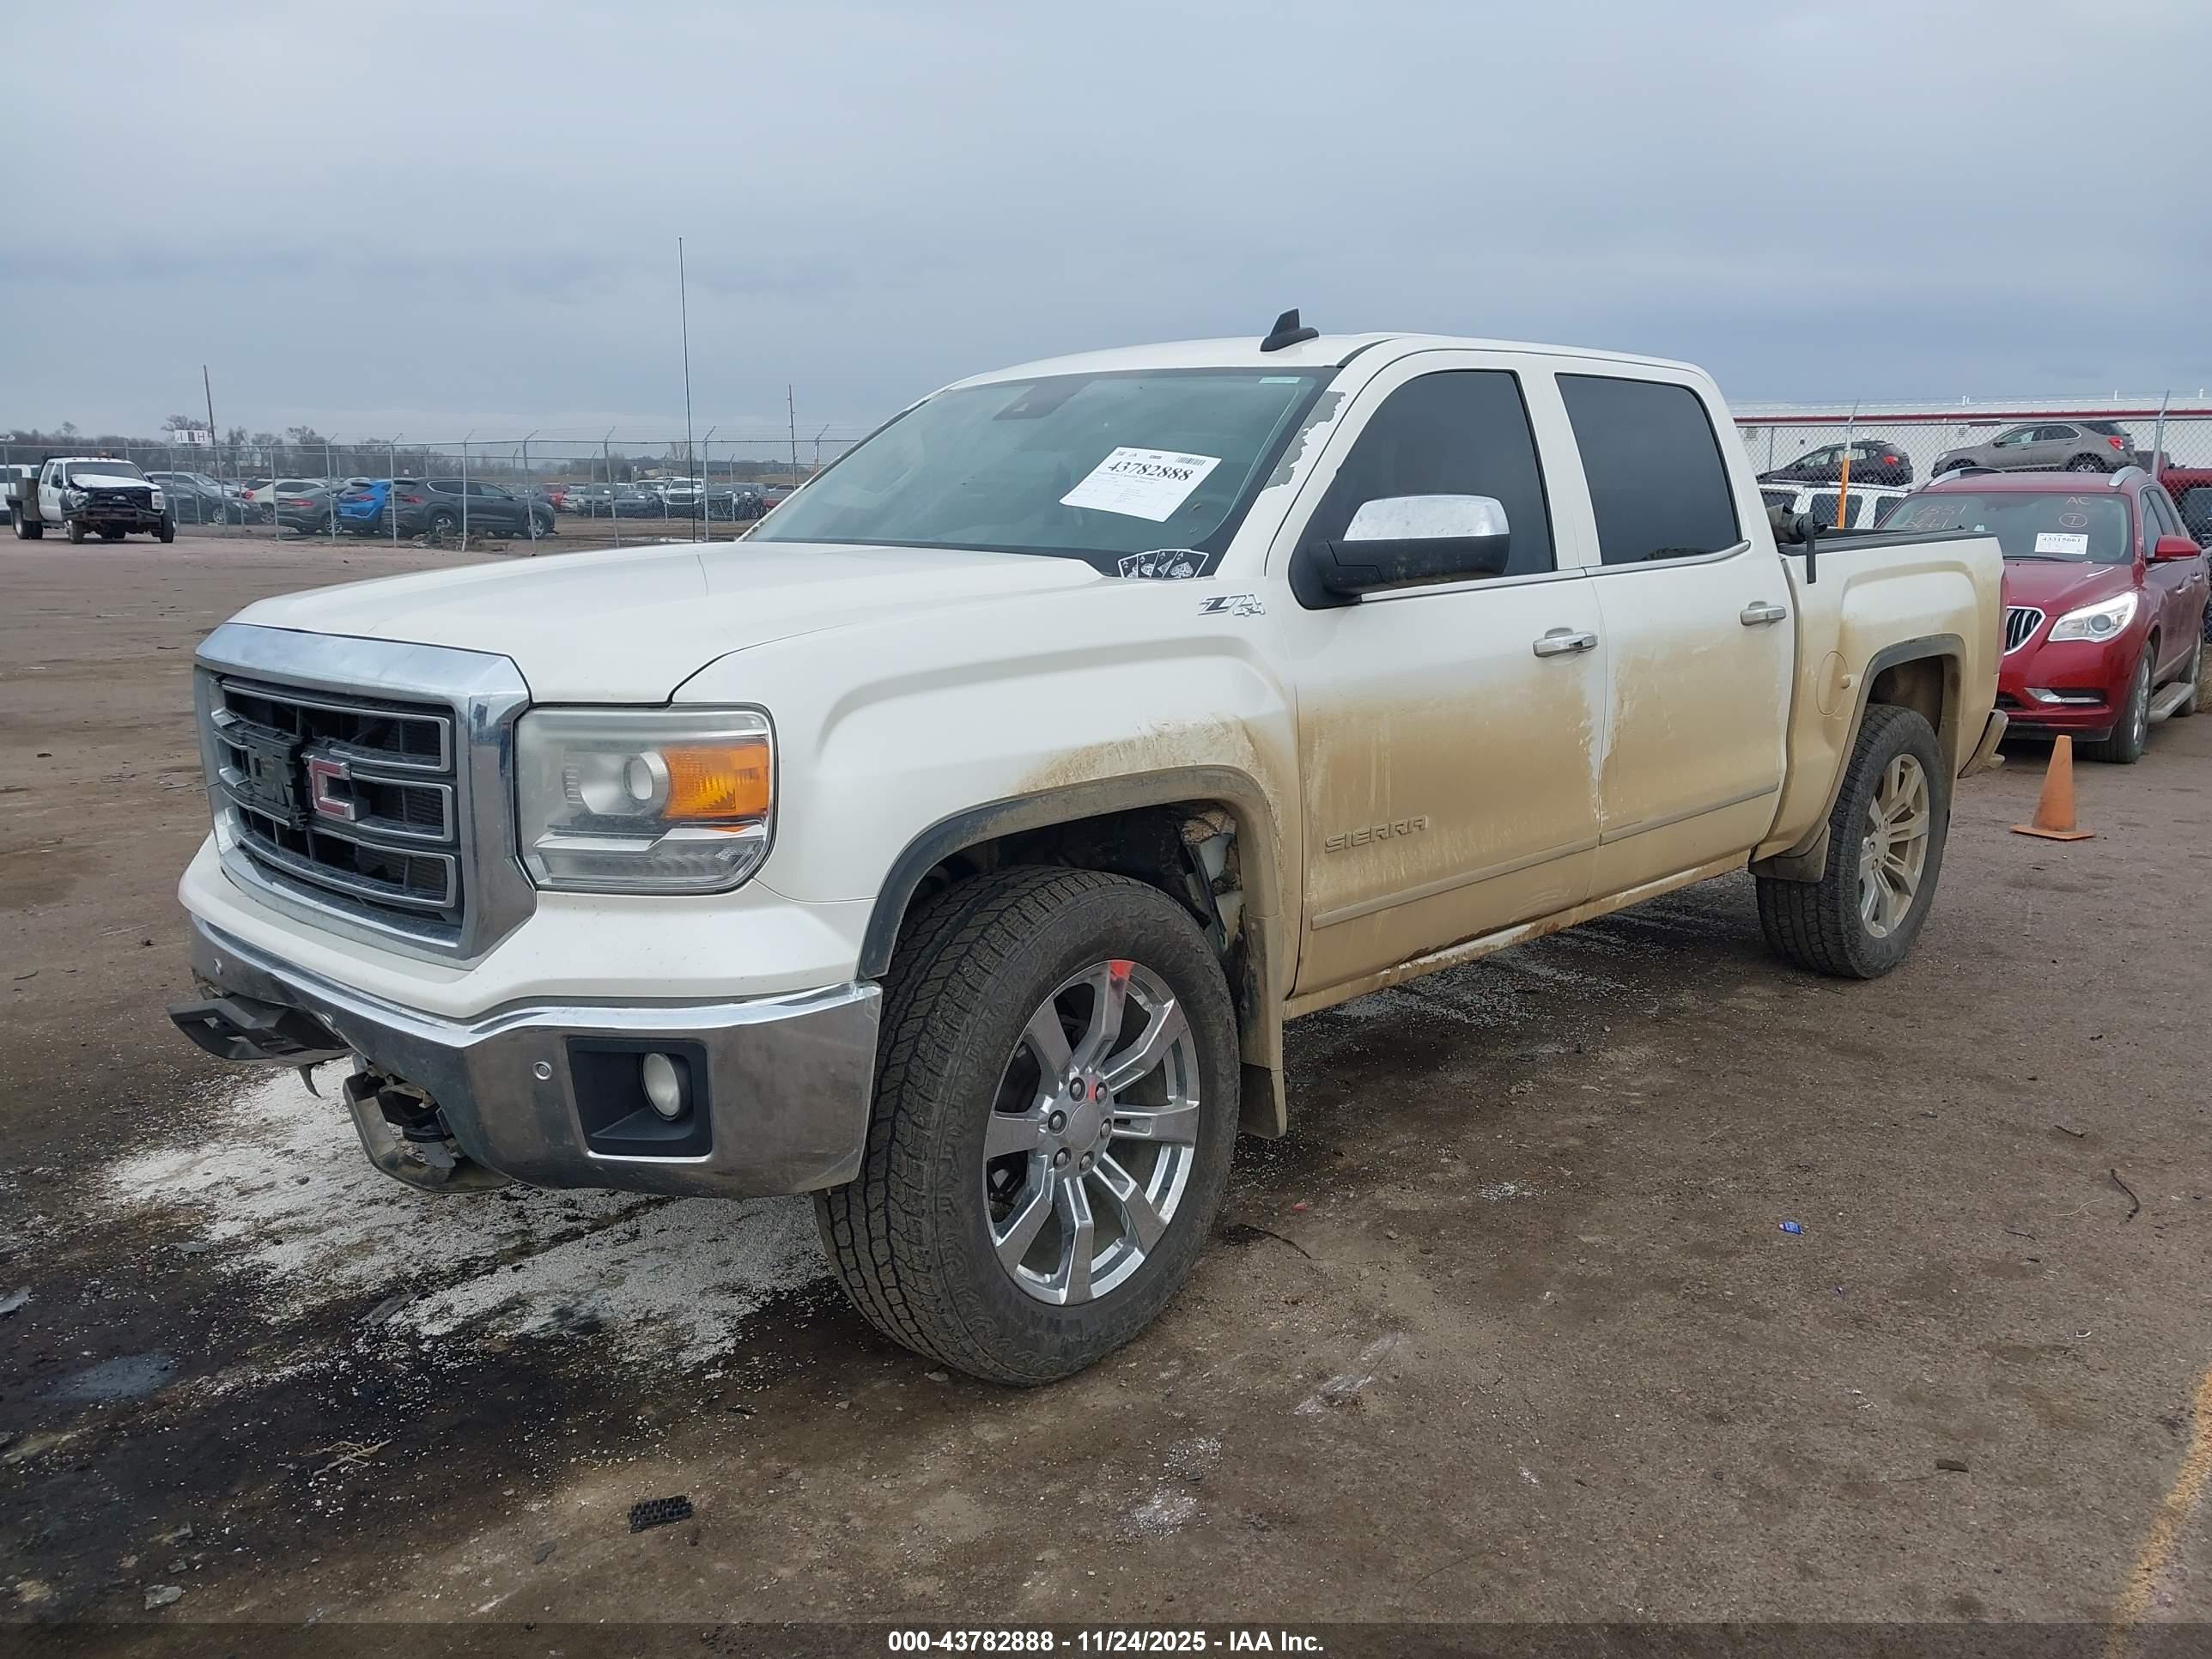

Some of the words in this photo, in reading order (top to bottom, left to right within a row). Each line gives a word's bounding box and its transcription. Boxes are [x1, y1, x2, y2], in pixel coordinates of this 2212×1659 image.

[1108, 460, 1194, 481] 43782888
[2066, 496, 2091, 505] AC
[1324, 815, 1427, 854] SIERRA
